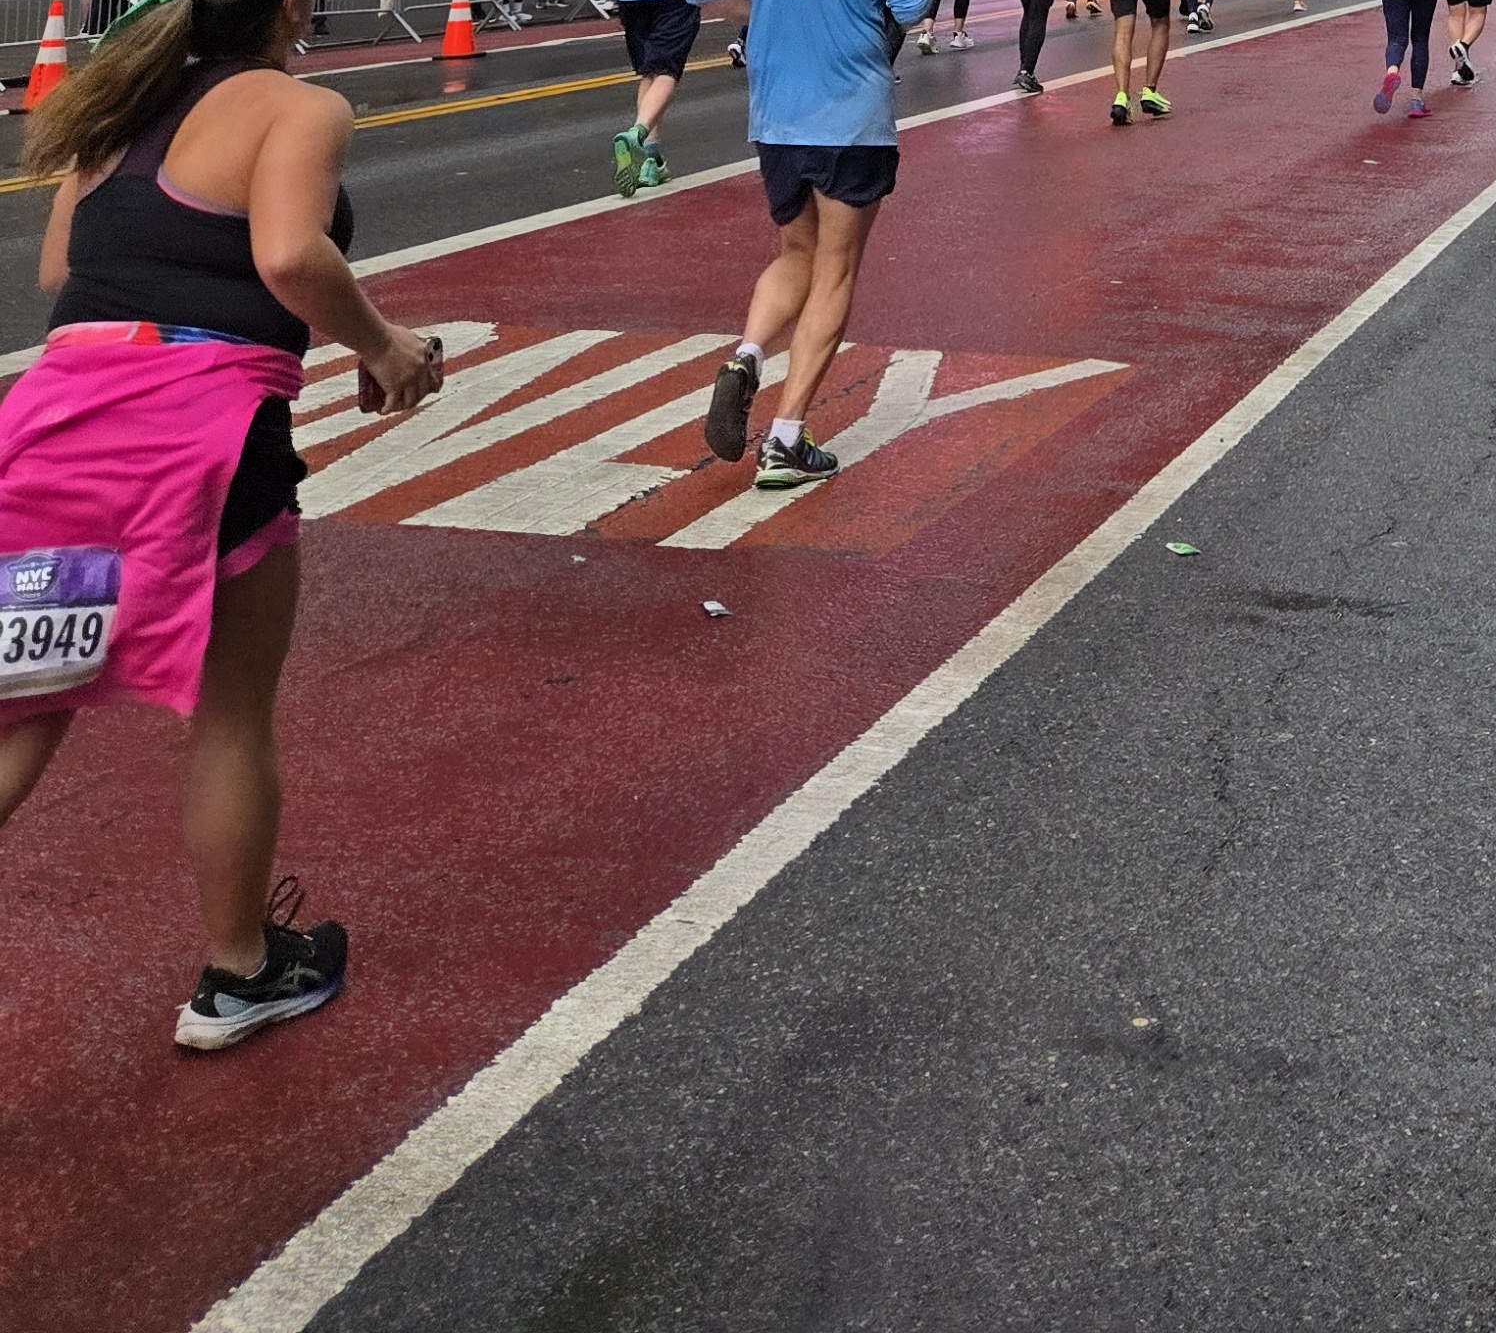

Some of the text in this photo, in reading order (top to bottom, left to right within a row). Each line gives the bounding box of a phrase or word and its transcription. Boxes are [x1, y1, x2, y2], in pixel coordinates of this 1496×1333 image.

[15, 566, 53, 584] NYC
[16, 580, 49, 593] HALF
[0, 611, 104, 664] 3949
